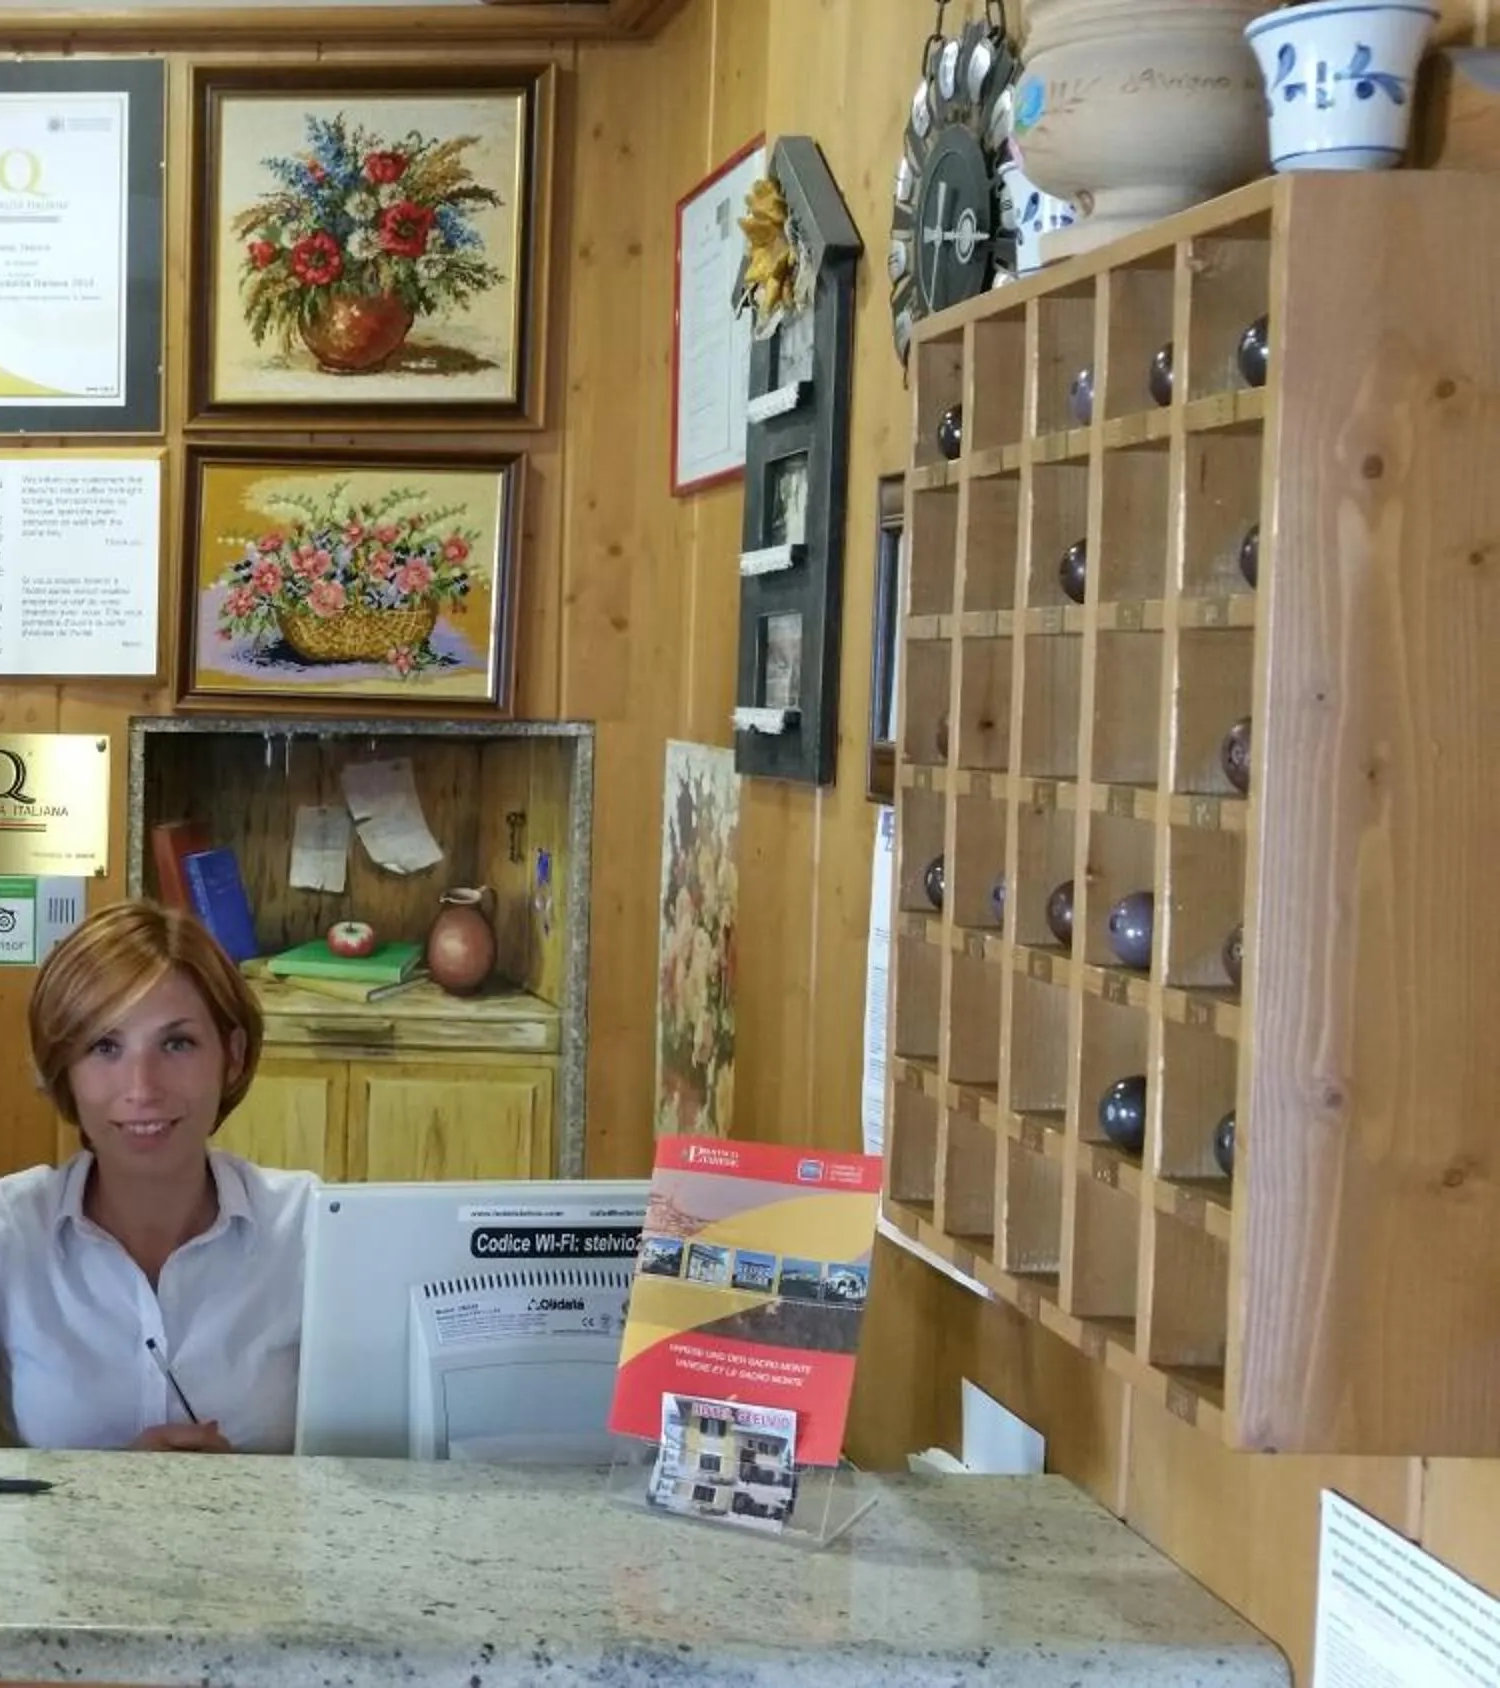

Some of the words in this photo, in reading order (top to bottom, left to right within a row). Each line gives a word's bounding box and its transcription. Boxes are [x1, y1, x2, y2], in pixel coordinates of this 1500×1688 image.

[13, 804, 69, 817] ITALIANA
[477, 1232, 531, 1253] Codice
[737, 1409, 791, 1428] STELVIO
